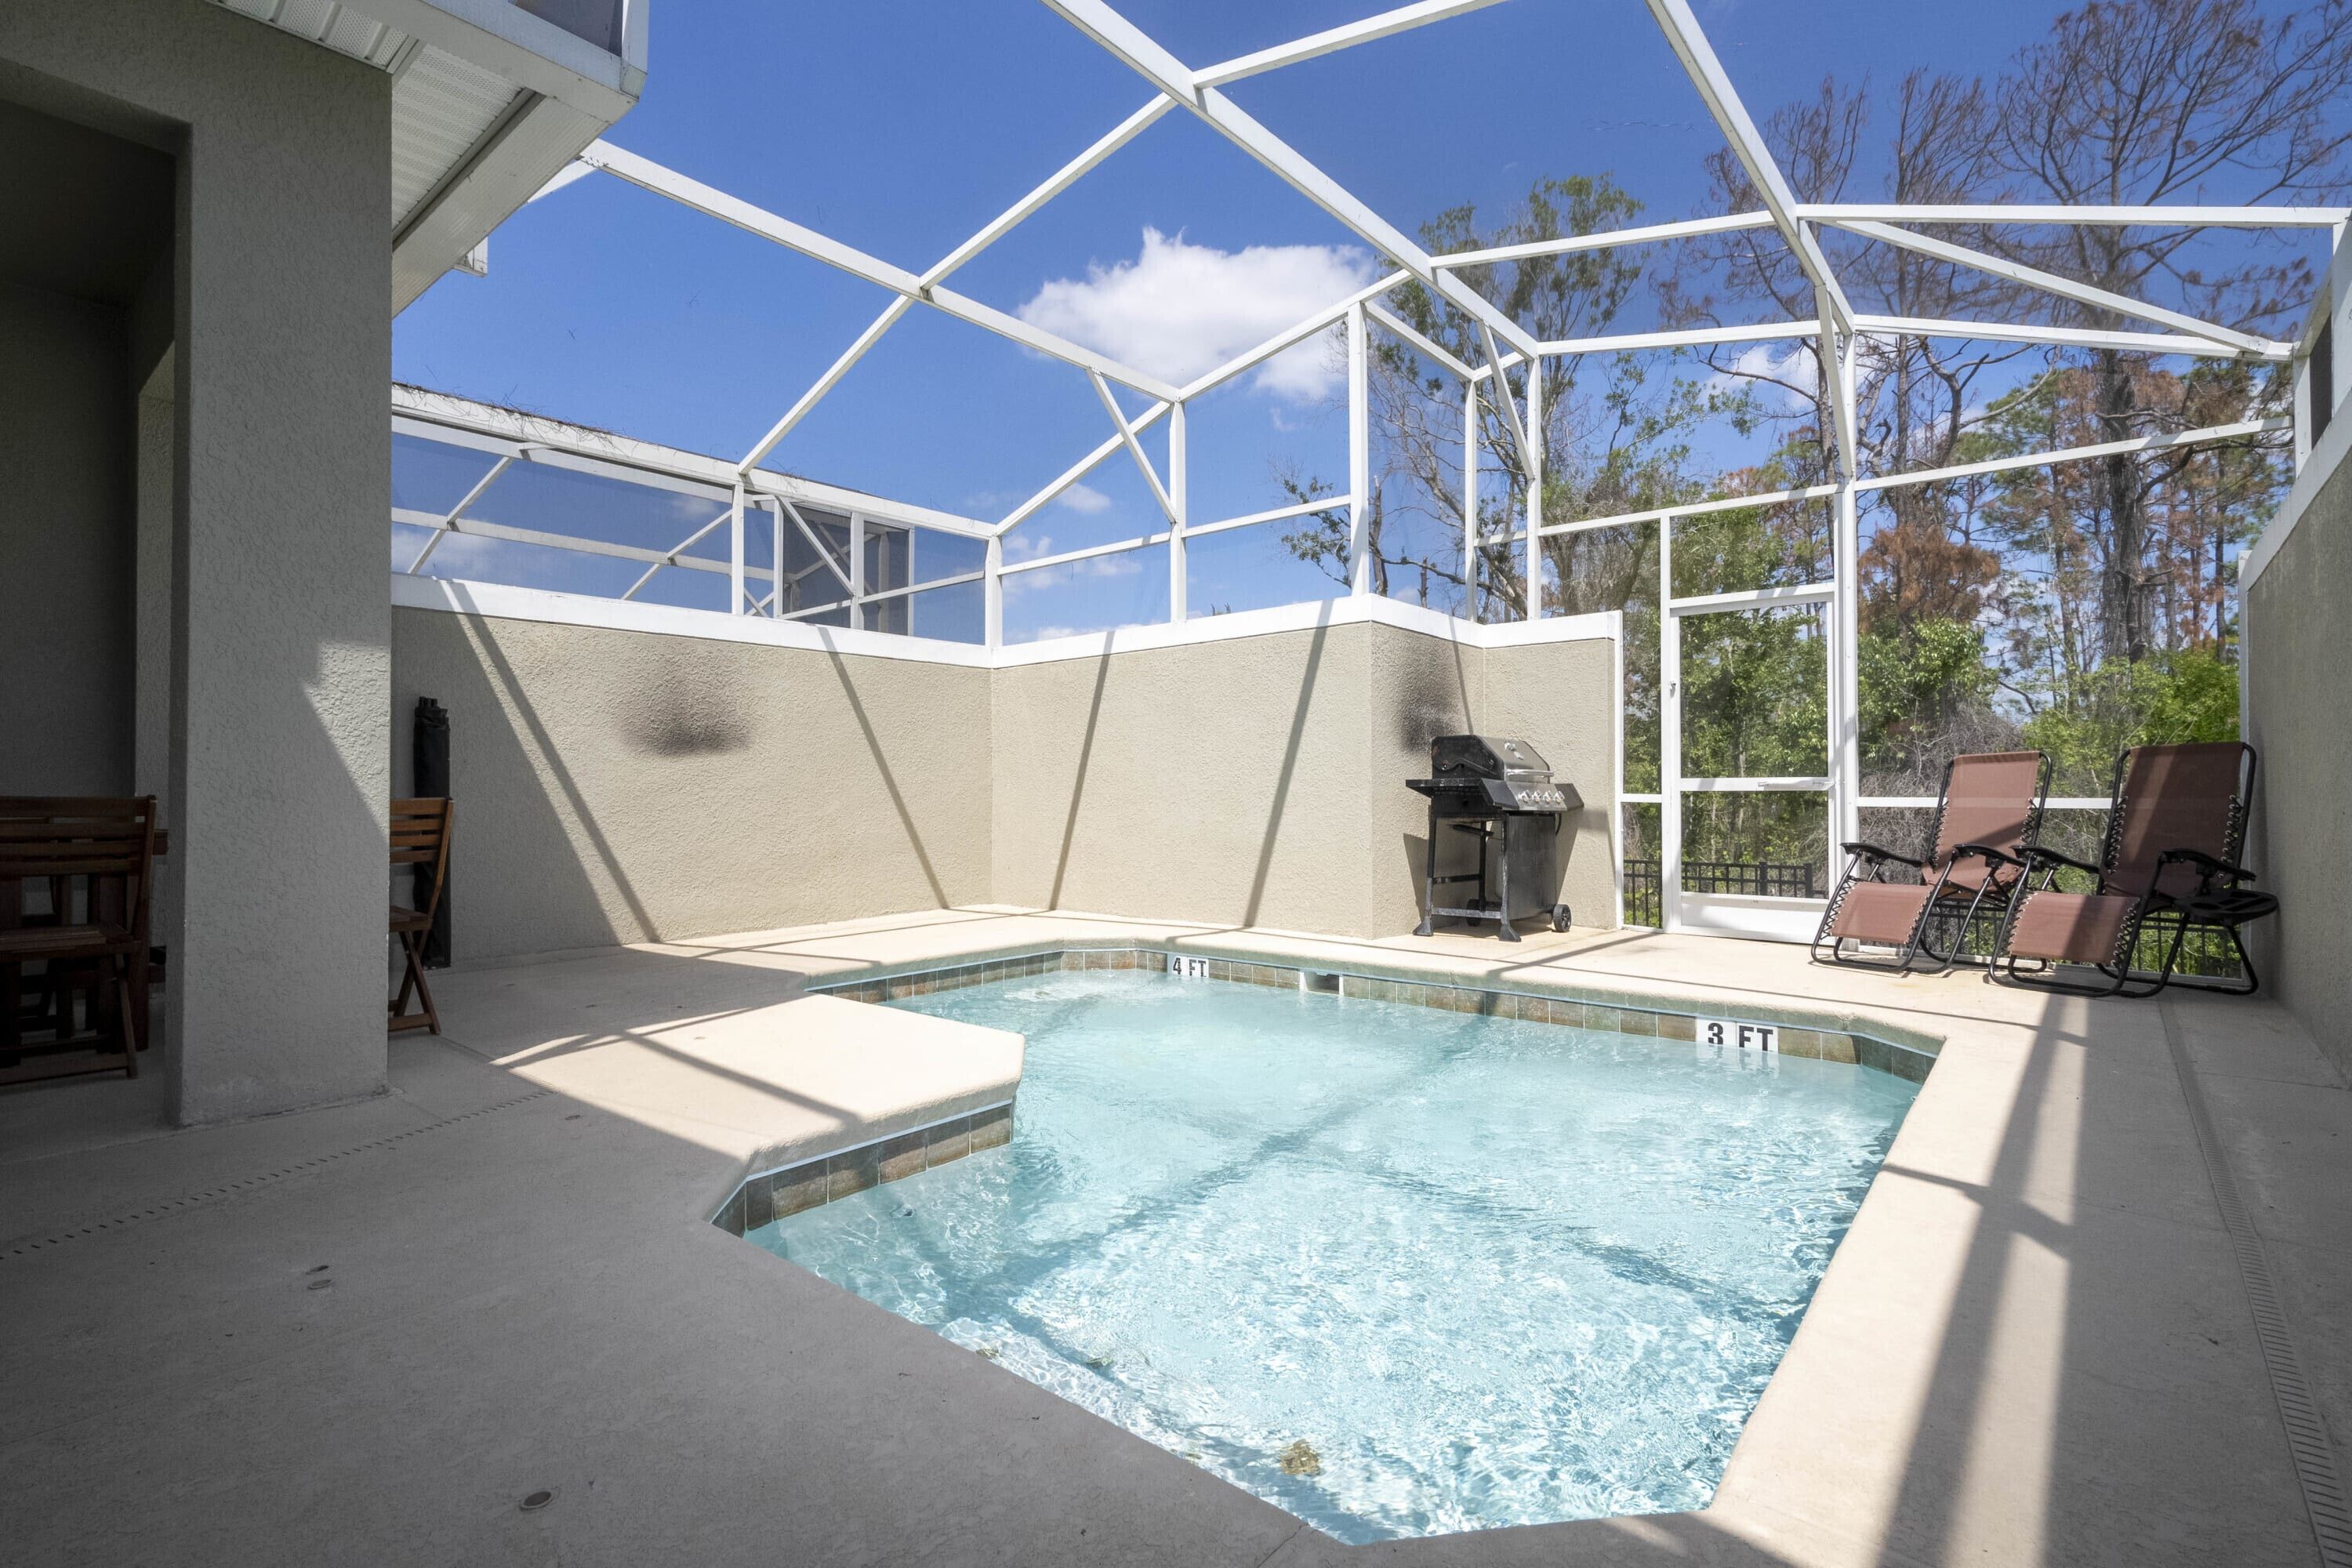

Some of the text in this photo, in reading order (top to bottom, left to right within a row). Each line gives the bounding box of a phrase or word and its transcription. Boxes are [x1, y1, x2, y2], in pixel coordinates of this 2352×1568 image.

[1173, 957, 1181, 975] 4
[1708, 1022, 1773, 1051] 3 FT
